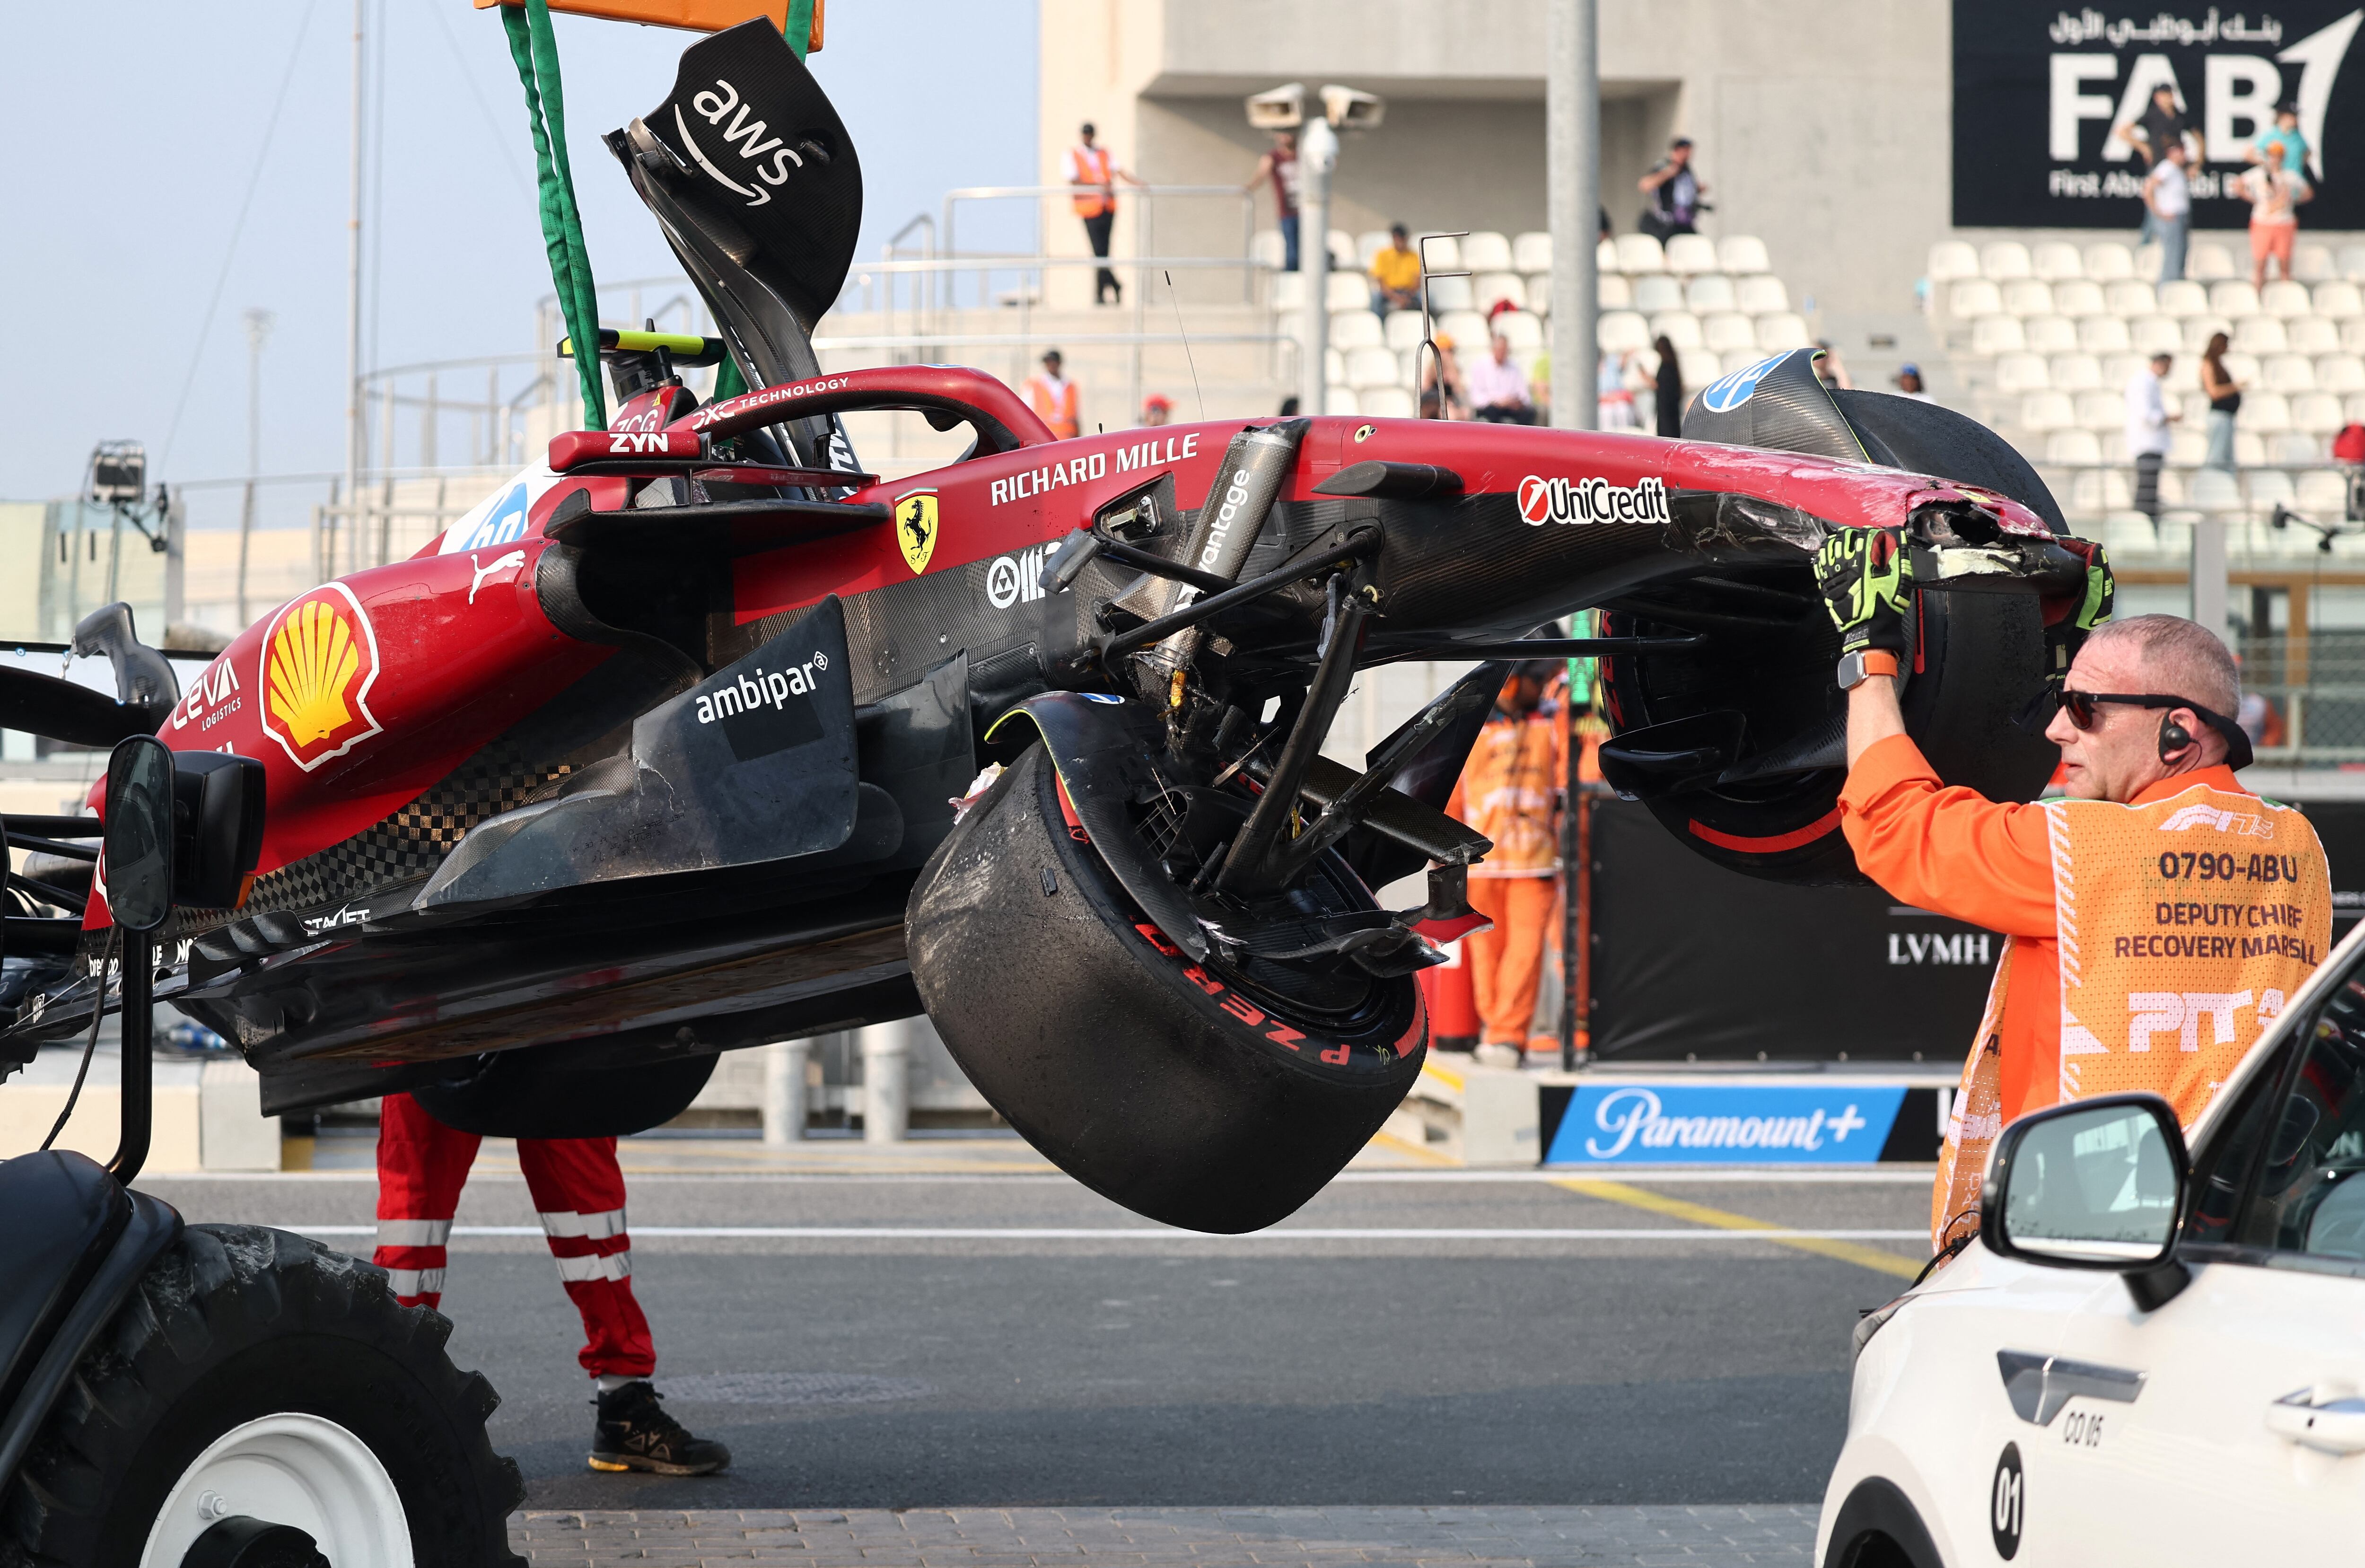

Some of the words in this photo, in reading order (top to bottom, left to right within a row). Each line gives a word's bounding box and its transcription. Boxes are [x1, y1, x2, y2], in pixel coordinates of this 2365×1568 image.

[693, 79, 803, 185] aws
[692, 400, 735, 430] DXC
[740, 377, 850, 408] TECHNOLOGY
[609, 432, 668, 453] ZYN
[991, 453, 1106, 507] RICHARD
[1116, 432, 1200, 473] MILLE
[1550, 479, 1667, 521] UniCredit
[696, 658, 817, 724] ambipar
[202, 697, 241, 732] LOGISTICS
[2159, 851, 2298, 883] 0790-ABU
[2156, 902, 2243, 927] DEPUTY
[2247, 903, 2303, 929] CHIEF
[1887, 933, 1989, 965] LVMH
[2115, 935, 2237, 958] RECOVERY
[1585, 1087, 1865, 1159] Paramount+
[1995, 1467, 2021, 1536] 01
